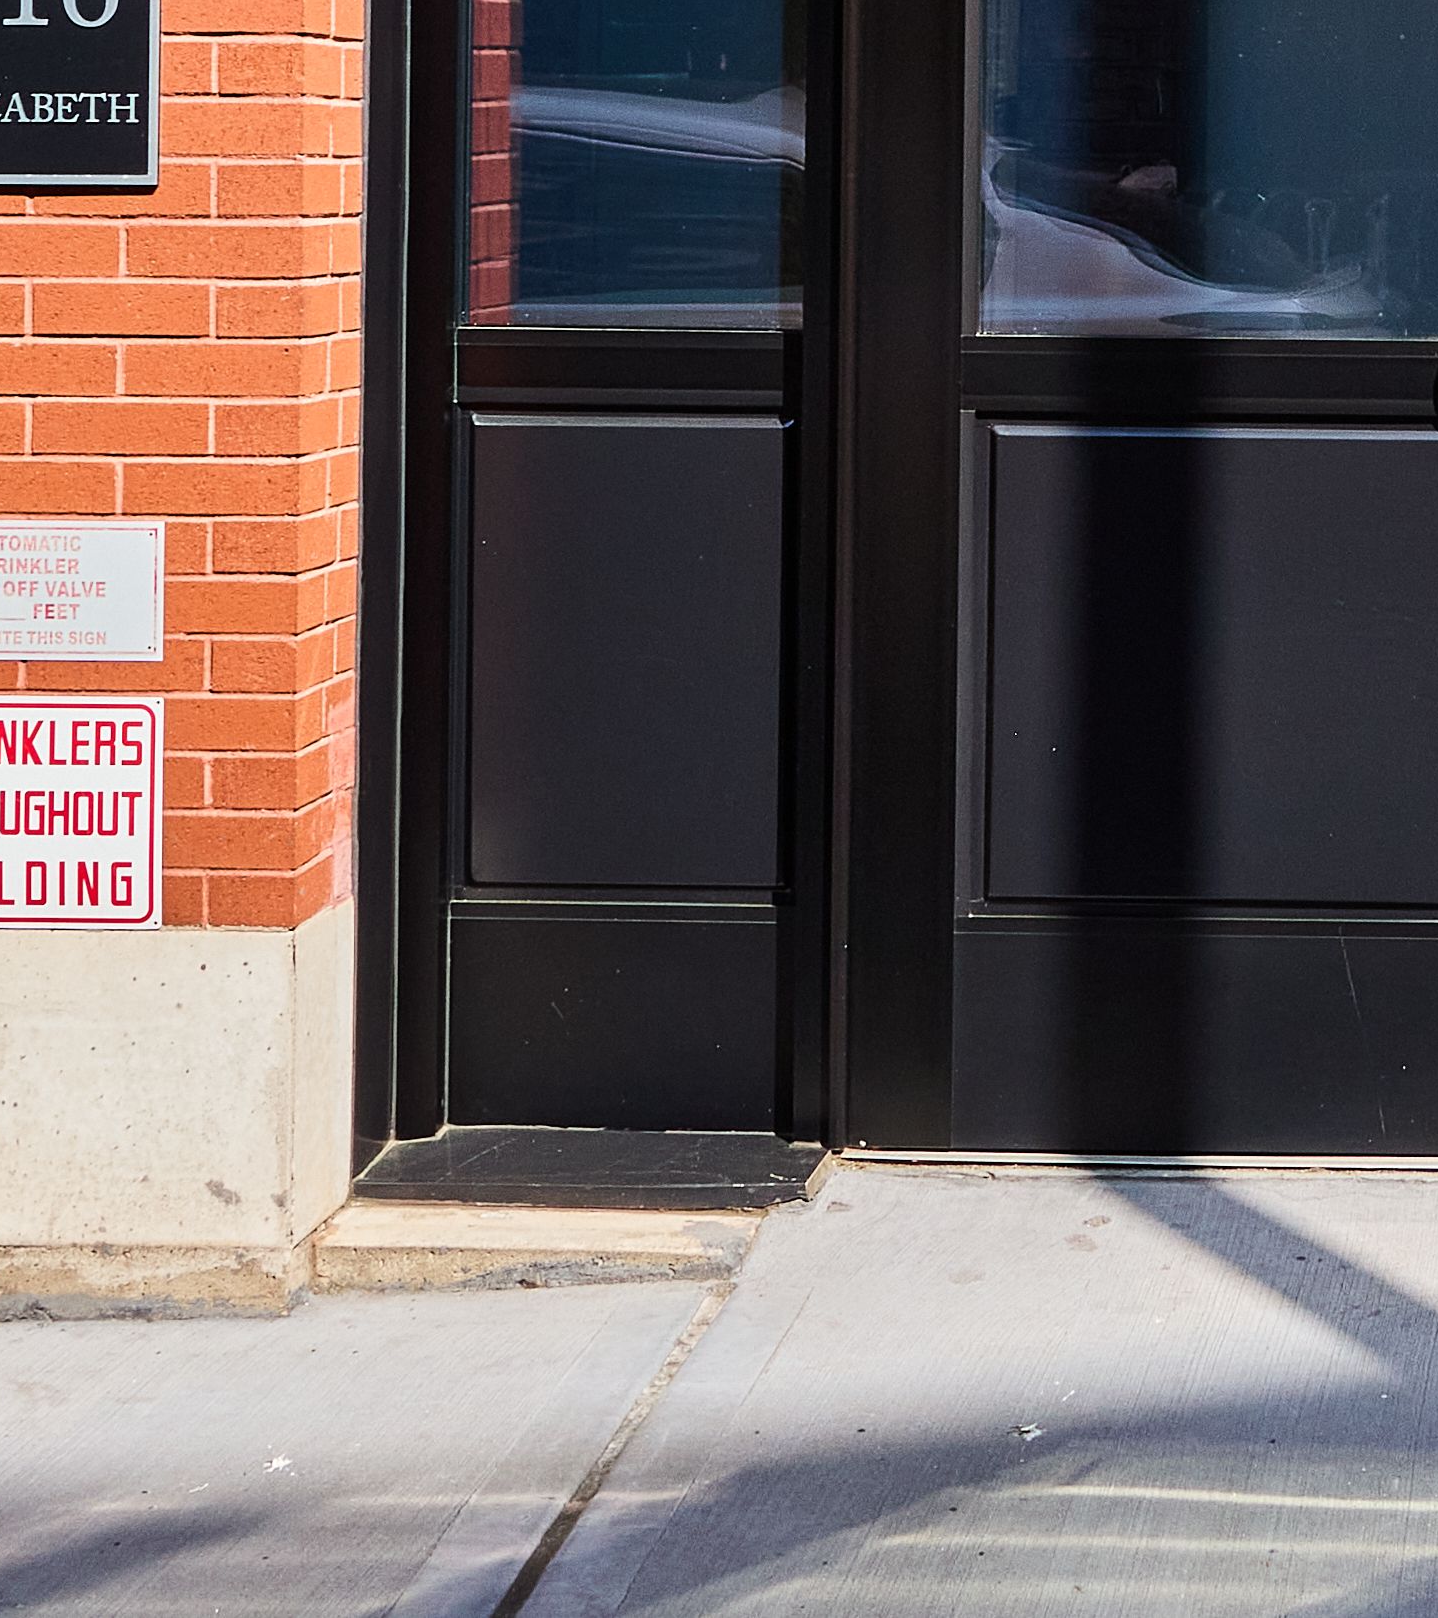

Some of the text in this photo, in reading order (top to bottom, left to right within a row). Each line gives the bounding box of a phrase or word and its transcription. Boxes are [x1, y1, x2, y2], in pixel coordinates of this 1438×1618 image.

[3, 581, 38, 598] OFF
[45, 581, 107, 598] VALVE
[32, 603, 81, 620] FEET
[27, 630, 64, 646] THIS
[68, 631, 107, 646] SIGN
